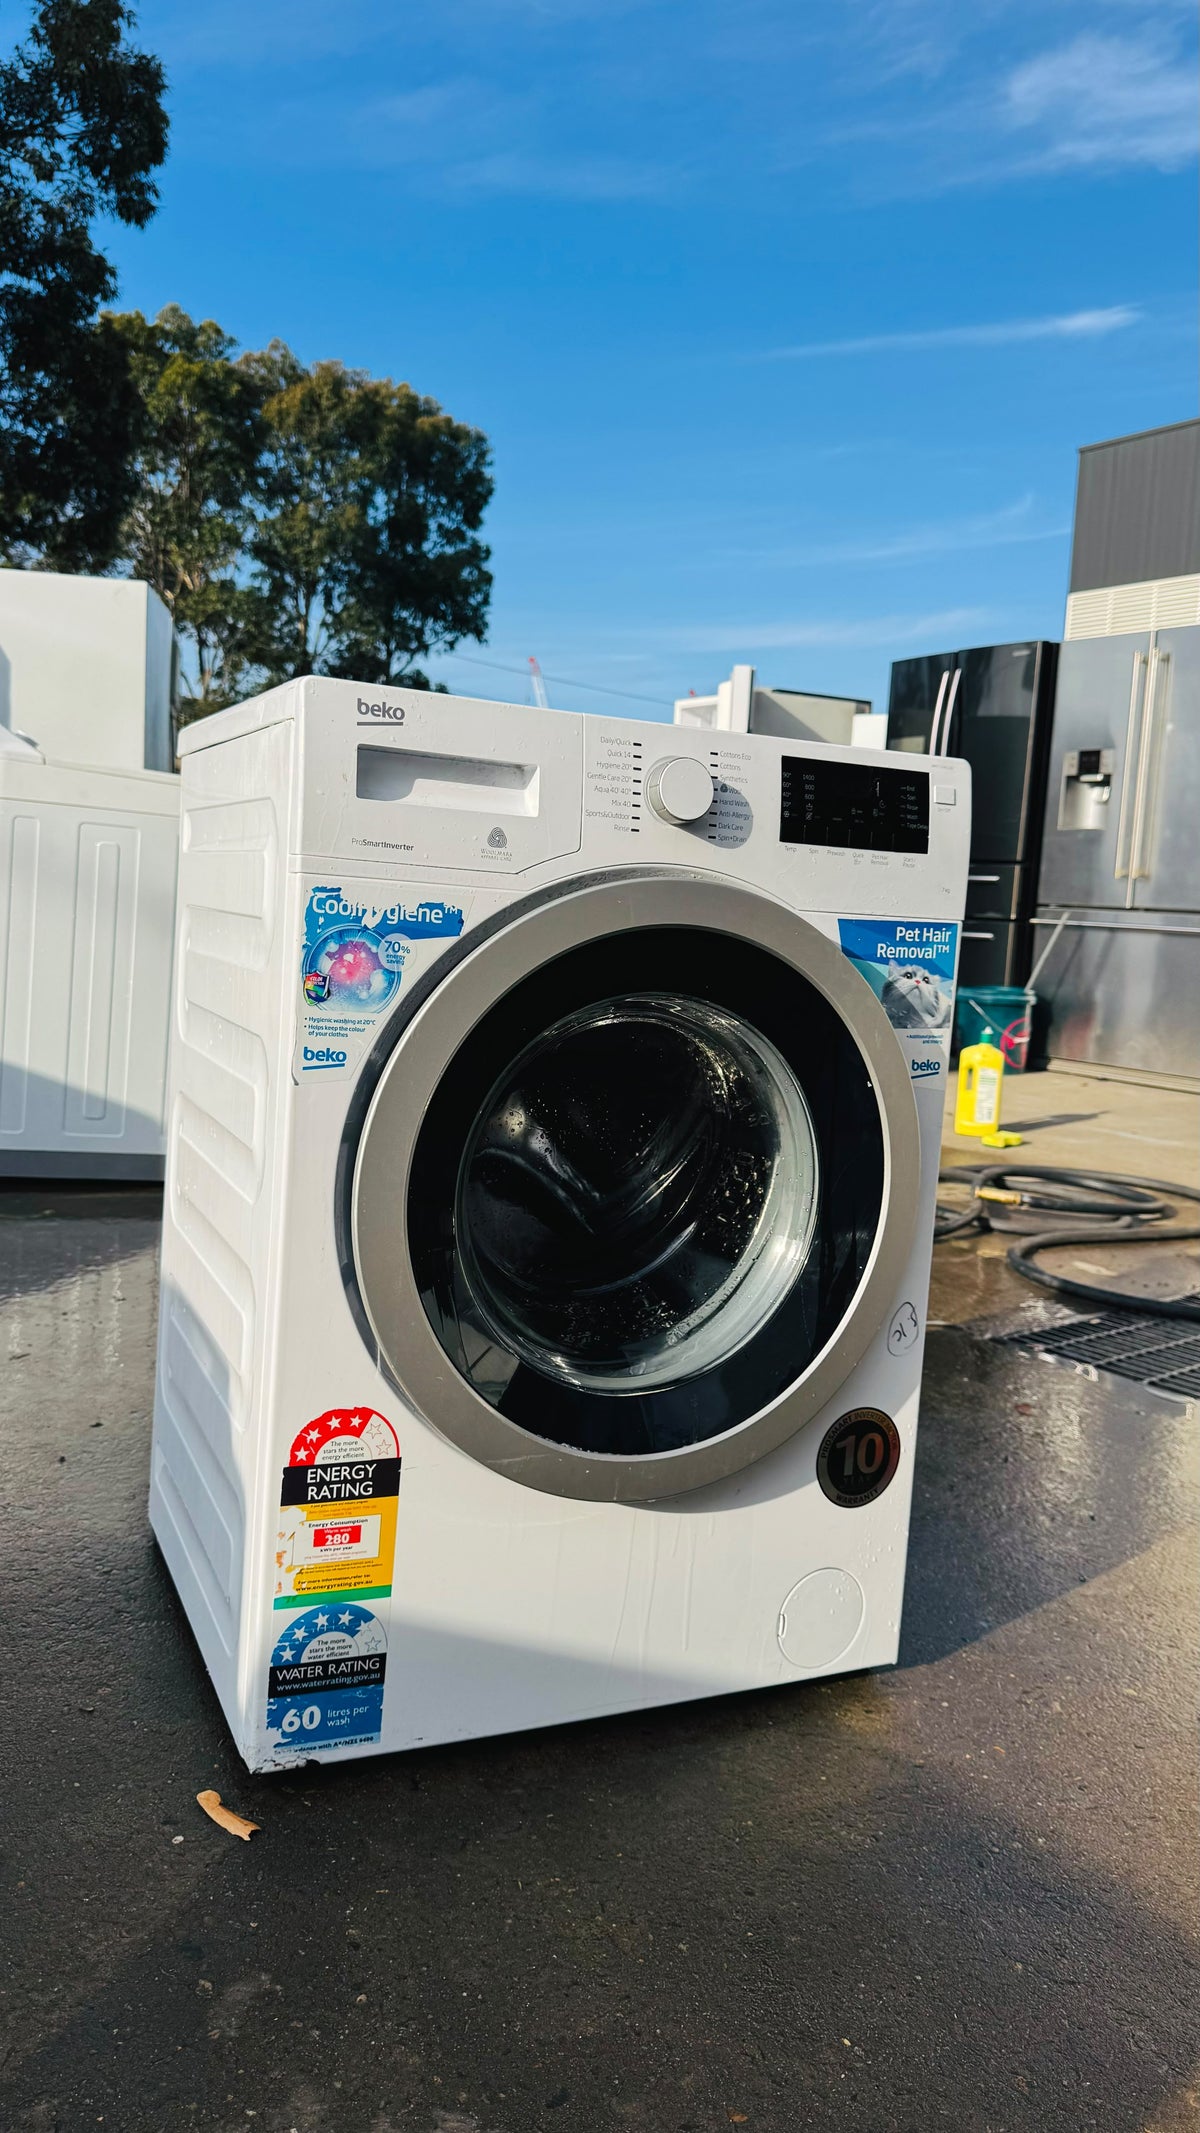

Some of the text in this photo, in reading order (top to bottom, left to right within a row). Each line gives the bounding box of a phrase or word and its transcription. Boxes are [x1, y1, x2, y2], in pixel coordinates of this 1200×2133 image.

[357, 697, 406, 721] beko
[351, 837, 415, 852] ProSmartInverter
[896, 926, 951, 943] Pet Hair
[384, 940, 411, 954] 70%
[877, 943, 950, 959] Removal™
[303, 1046, 347, 1063] beko
[911, 1059, 941, 1072] beko
[836, 1432, 885, 1476] 10
[306, 1463, 377, 1483] ENERGY
[307, 1481, 373, 1501] RATING
[329, 1519, 369, 1527] Consumption
[325, 1532, 350, 1546] 280
[326, 1650, 350, 1658] efficient
[276, 1657, 380, 1681] WATER RATING
[276, 1672, 381, 1692] www.waterrating.gov.au
[281, 1705, 322, 1733] 60
[327, 1705, 370, 1719] litres per
[326, 1716, 350, 1727] wash
